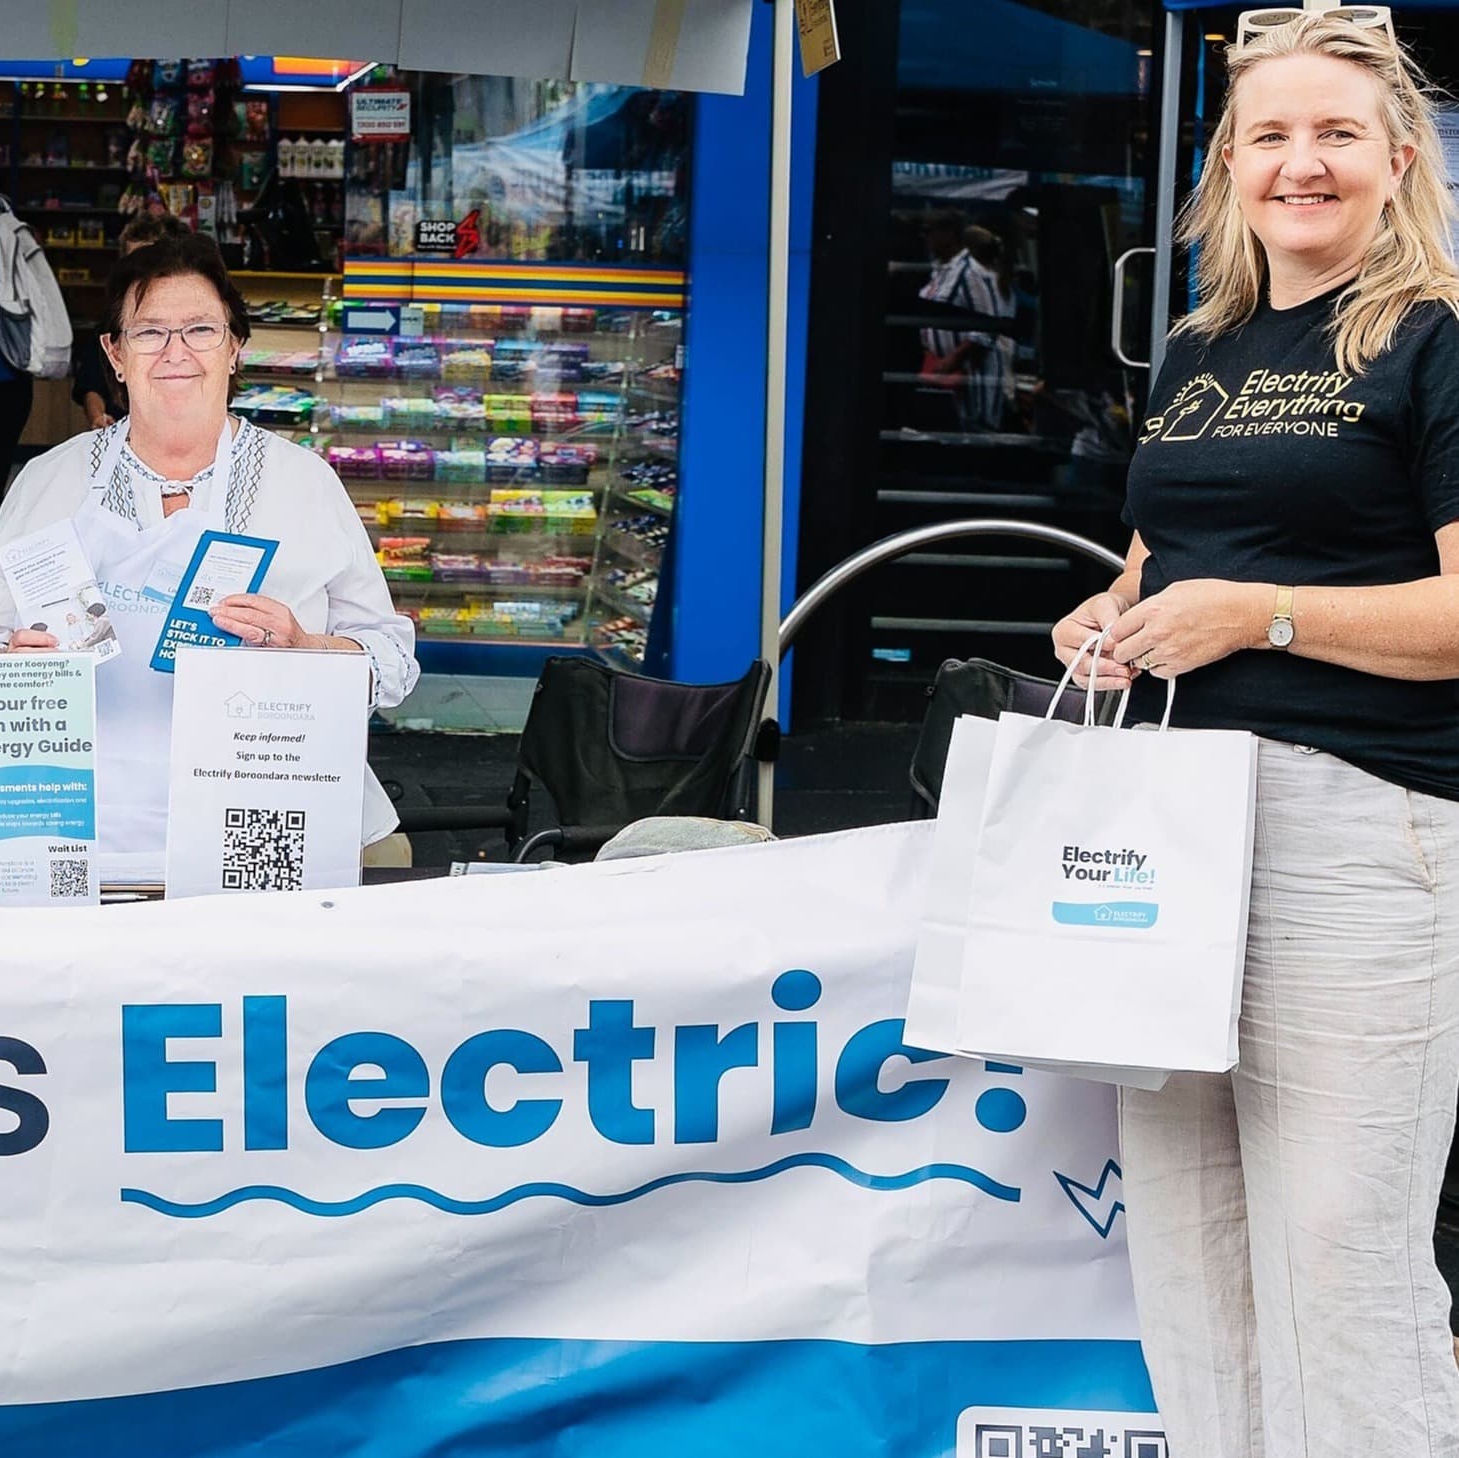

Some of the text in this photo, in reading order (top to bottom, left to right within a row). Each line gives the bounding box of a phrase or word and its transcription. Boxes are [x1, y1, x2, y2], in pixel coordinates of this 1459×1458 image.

[420, 222, 456, 232] SHOP
[420, 233, 455, 243] BACK
[1240, 369, 1353, 398] Electrify
[1224, 394, 1366, 423] Everything
[1211, 421, 1340, 439] FOR EVERYONE
[170, 619, 197, 631] LET'S
[166, 629, 198, 642] STICK
[199, 635, 210, 644] IT
[211, 637, 226, 647] TO
[25, 660, 70, 670] Kooyong?
[21, 671, 53, 680] energy
[55, 670, 73, 678] bills
[13, 680, 54, 689] comfort?
[30, 696, 68, 710] free
[257, 702, 312, 713] ELECTRIFY
[10, 717, 52, 732] with
[55, 719, 67, 732] a
[233, 731, 306, 743] Keep informed!
[38, 738, 93, 753] Guide
[236, 751, 301, 763] Sign up to the
[193, 768, 342, 783] Electrify Boroondara newsletter
[39, 782, 61, 794] help
[62, 781, 88, 792] with:
[48, 845, 88, 854] Wait List
[1062, 845, 1148, 871] Electrify
[1062, 863, 1155, 884] Your Life!
